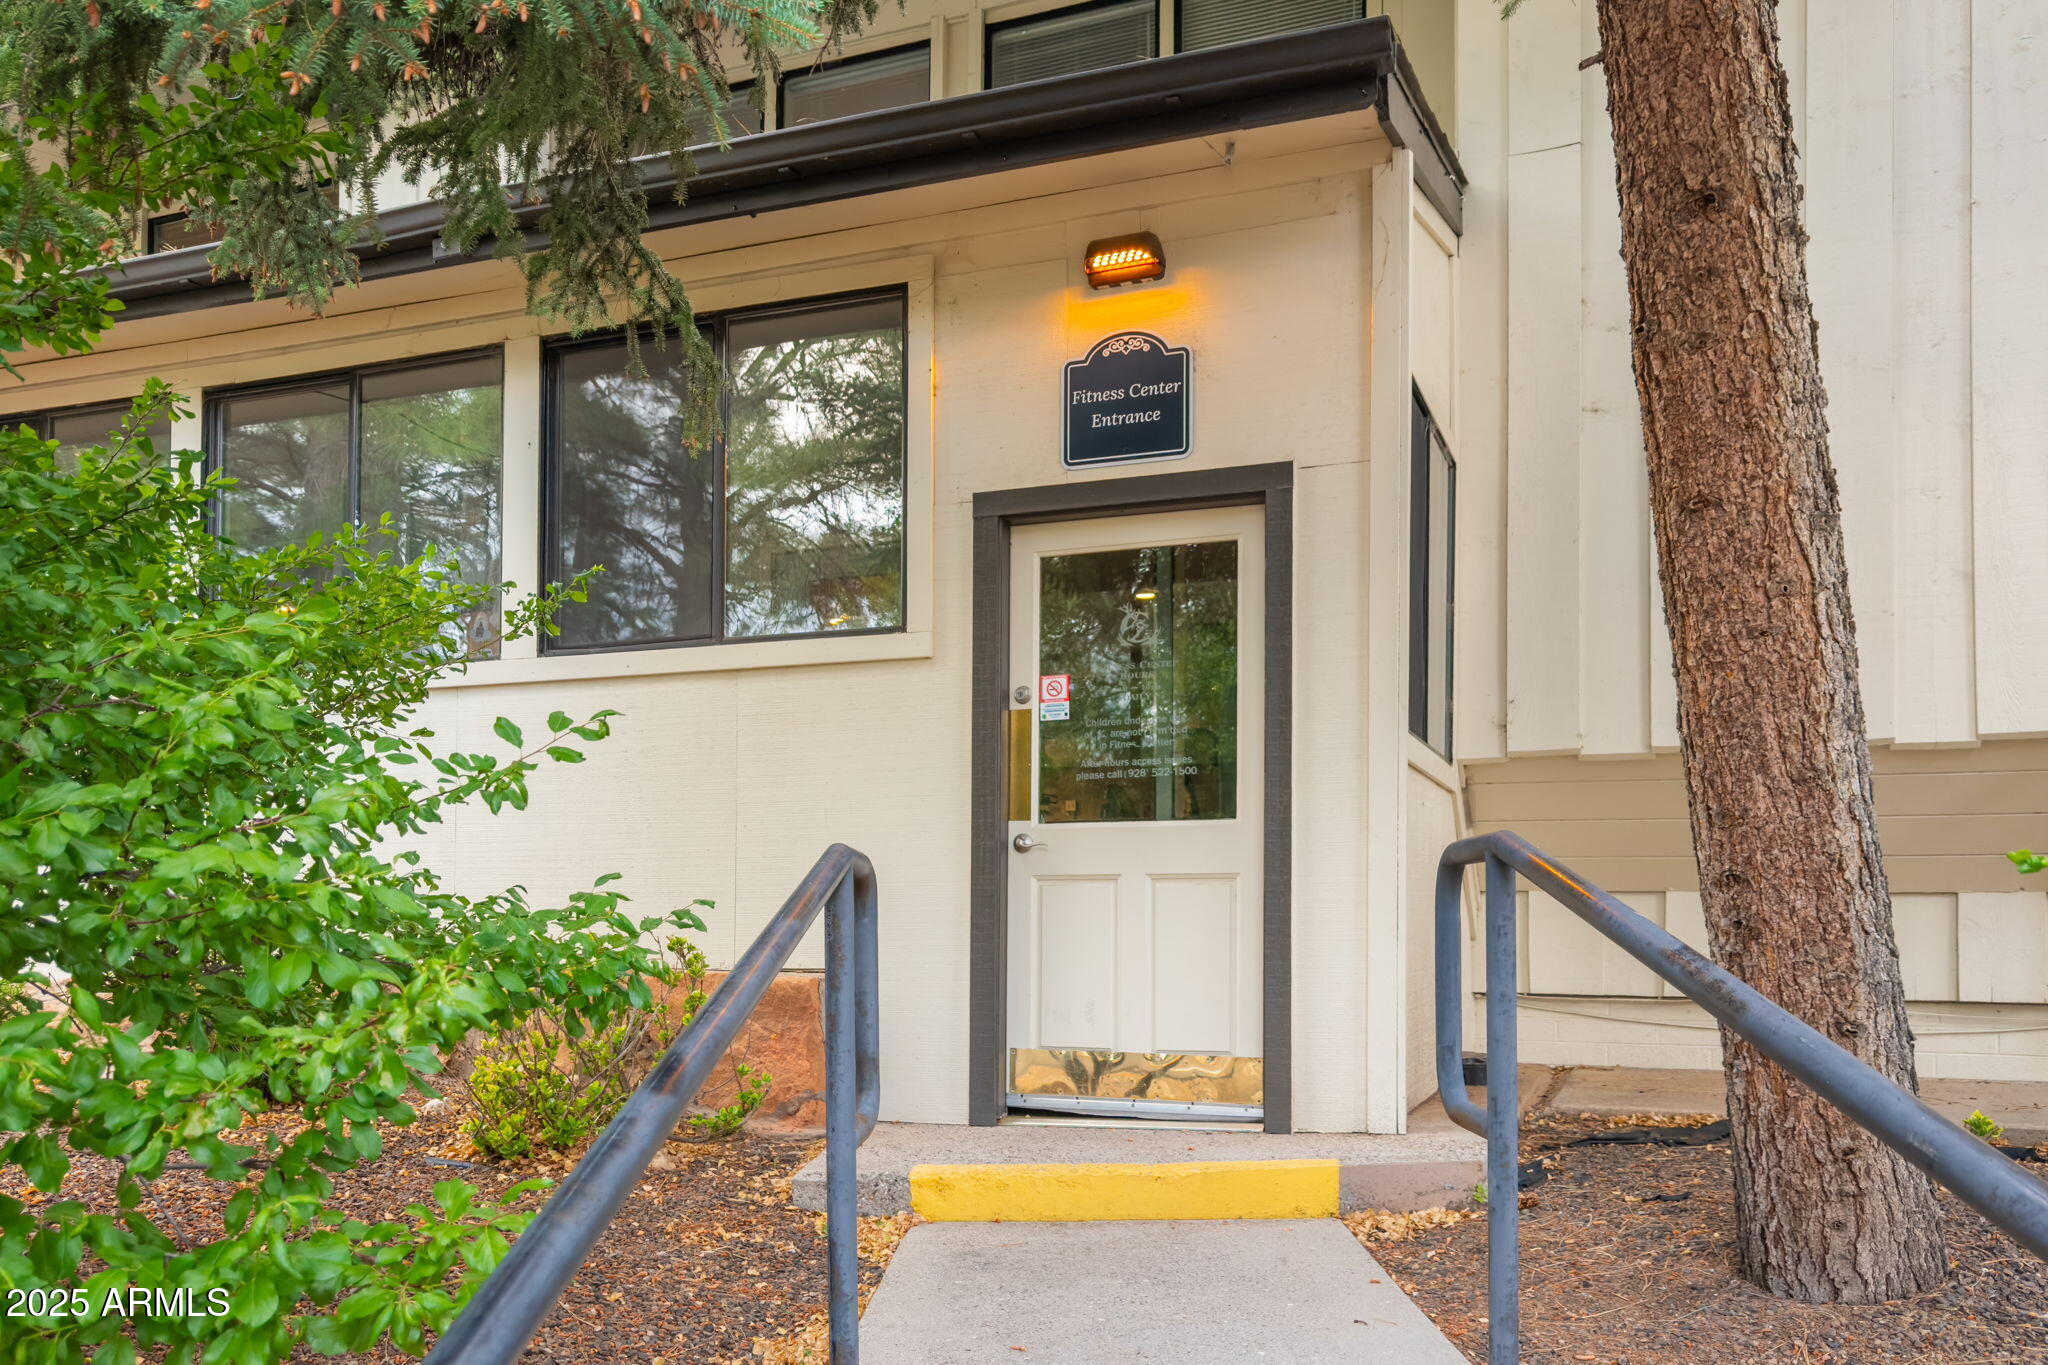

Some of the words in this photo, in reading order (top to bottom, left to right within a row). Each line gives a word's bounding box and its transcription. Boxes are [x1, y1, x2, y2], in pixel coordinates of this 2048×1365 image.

[1072, 388, 1125, 405] Fitness
[1129, 381, 1181, 398] Center
[1091, 410, 1161, 428] Entrance
[1085, 717, 1122, 727] Children
[1076, 771, 1105, 781] please
[1107, 769, 1122, 779] call
